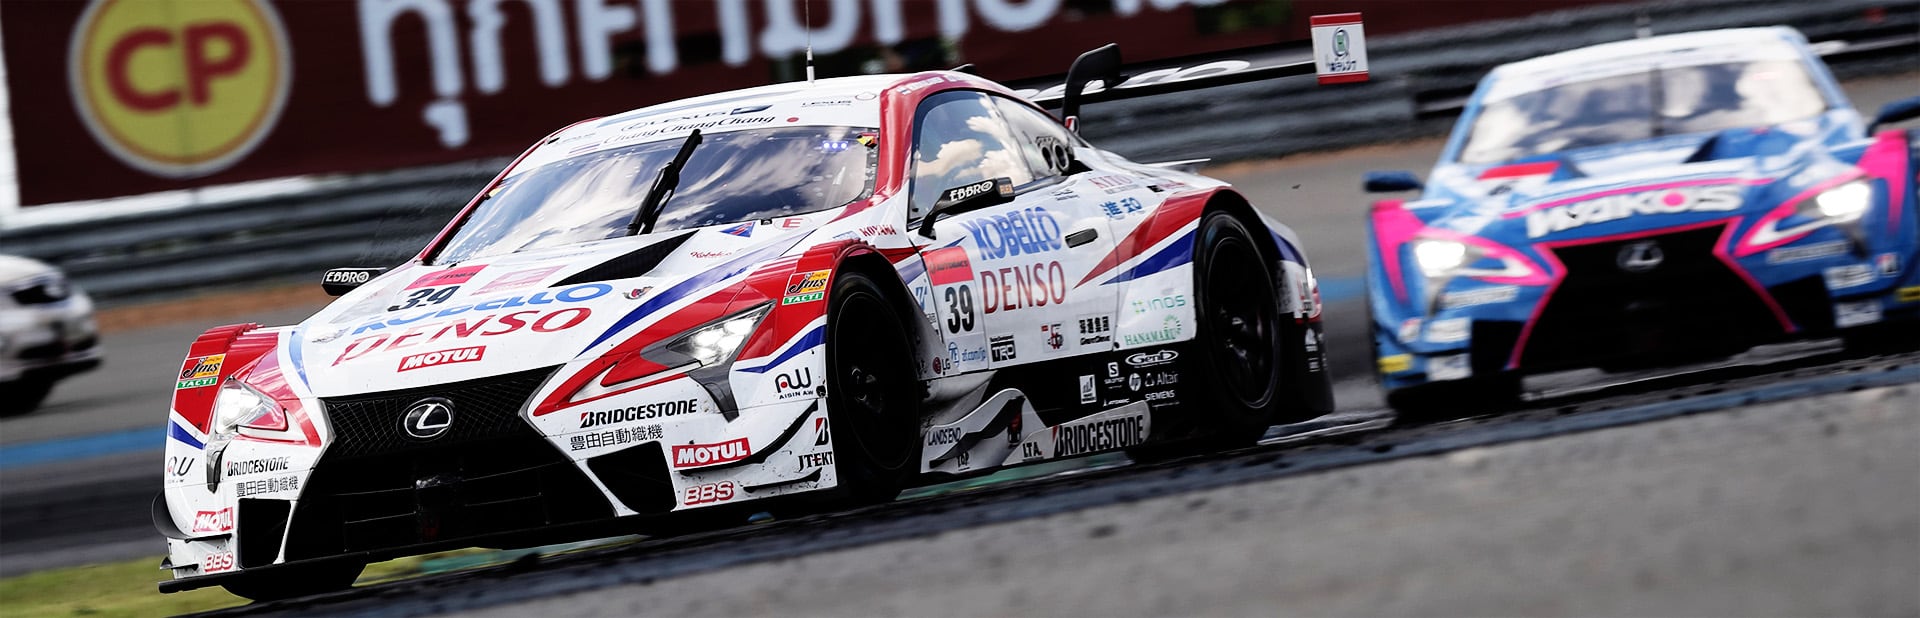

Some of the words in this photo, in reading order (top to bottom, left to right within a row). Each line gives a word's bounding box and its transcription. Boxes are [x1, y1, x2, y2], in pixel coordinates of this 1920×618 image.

[104, 20, 251, 114] CP
[658, 120, 716, 136] Chang
[717, 115, 776, 128] Chang
[950, 181, 993, 201] EBBRO
[960, 207, 1061, 260] KOBELCO
[325, 271, 370, 284] EBBRO
[980, 260, 1067, 314] DENSO
[387, 285, 461, 312] 39
[786, 292, 821, 303] TACTI
[945, 284, 975, 333] 39
[331, 307, 592, 367] DENSO
[401, 347, 482, 371] MOTUL
[991, 344, 1015, 361] TRD
[181, 378, 215, 388] TACTI
[1157, 371, 1179, 386] Altair
[779, 391, 801, 400] AISIN
[1145, 389, 1175, 401] SIEMENS
[580, 398, 697, 429] BRIDGESTONE
[1053, 415, 1144, 457] BRIDGESTONE
[677, 441, 748, 466] MOTUL
[798, 451, 834, 472] JTEKT
[227, 456, 291, 477] BRIDGESTONE
[684, 481, 734, 505] BBS
[195, 508, 233, 531] MOTUL
[204, 552, 234, 572] BBS
